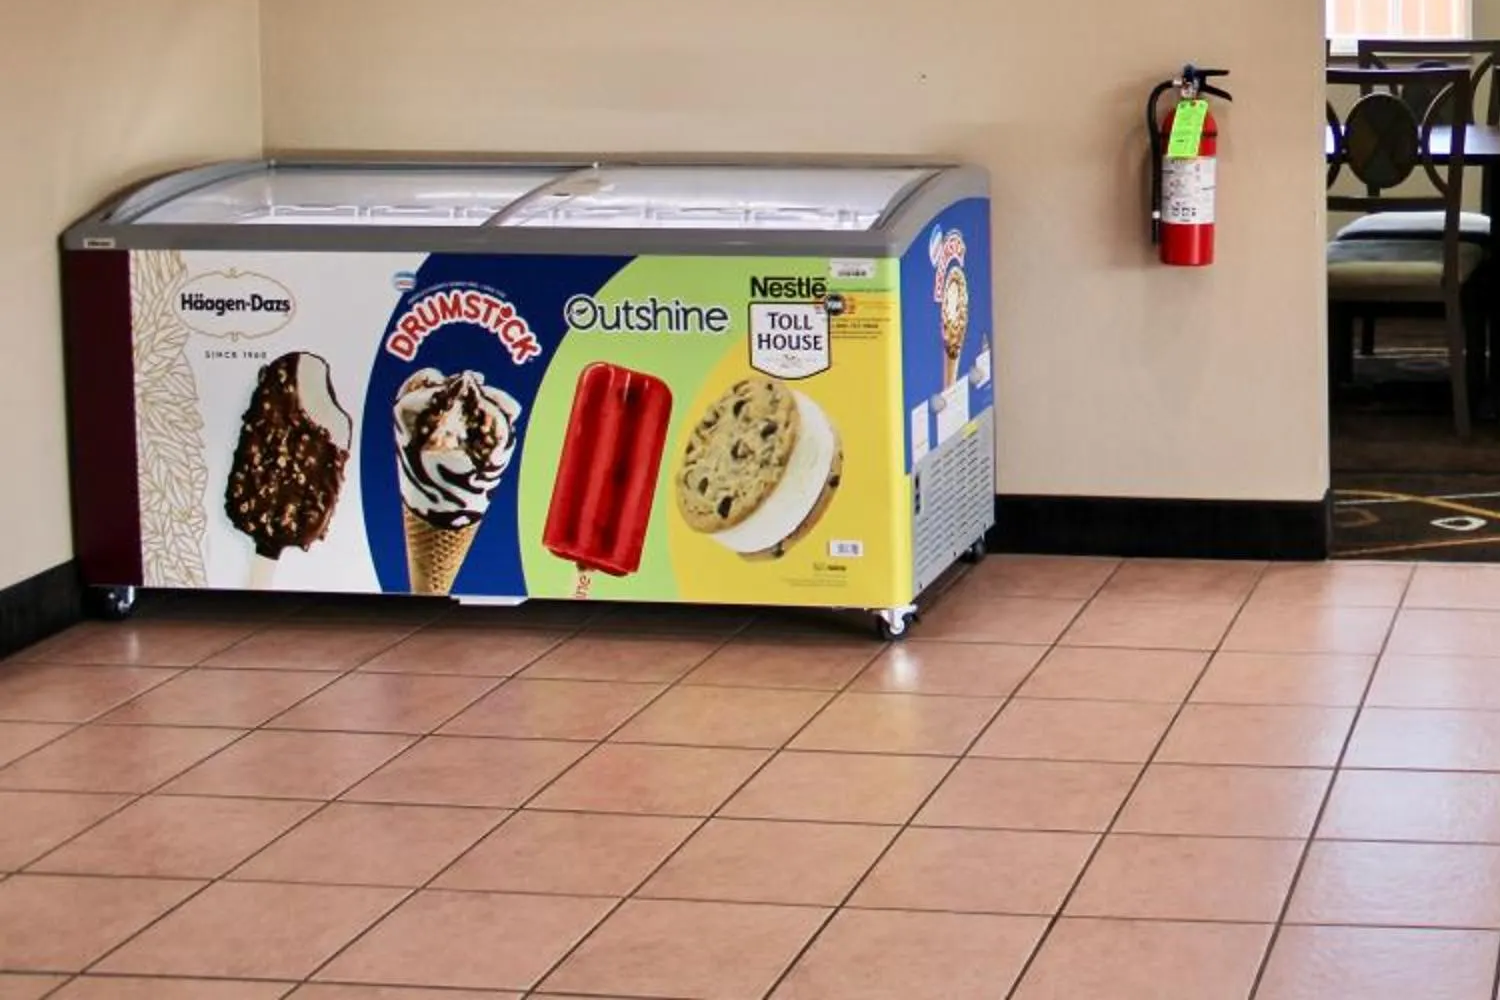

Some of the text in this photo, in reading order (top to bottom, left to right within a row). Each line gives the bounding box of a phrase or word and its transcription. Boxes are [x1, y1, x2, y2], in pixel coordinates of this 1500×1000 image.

[180, 293, 291, 317] Häagen-Dazs
[567, 296, 729, 332] Outshine
[767, 312, 813, 330] TOLL
[757, 333, 823, 351] HOUSE
[204, 350, 237, 359] SINCE
